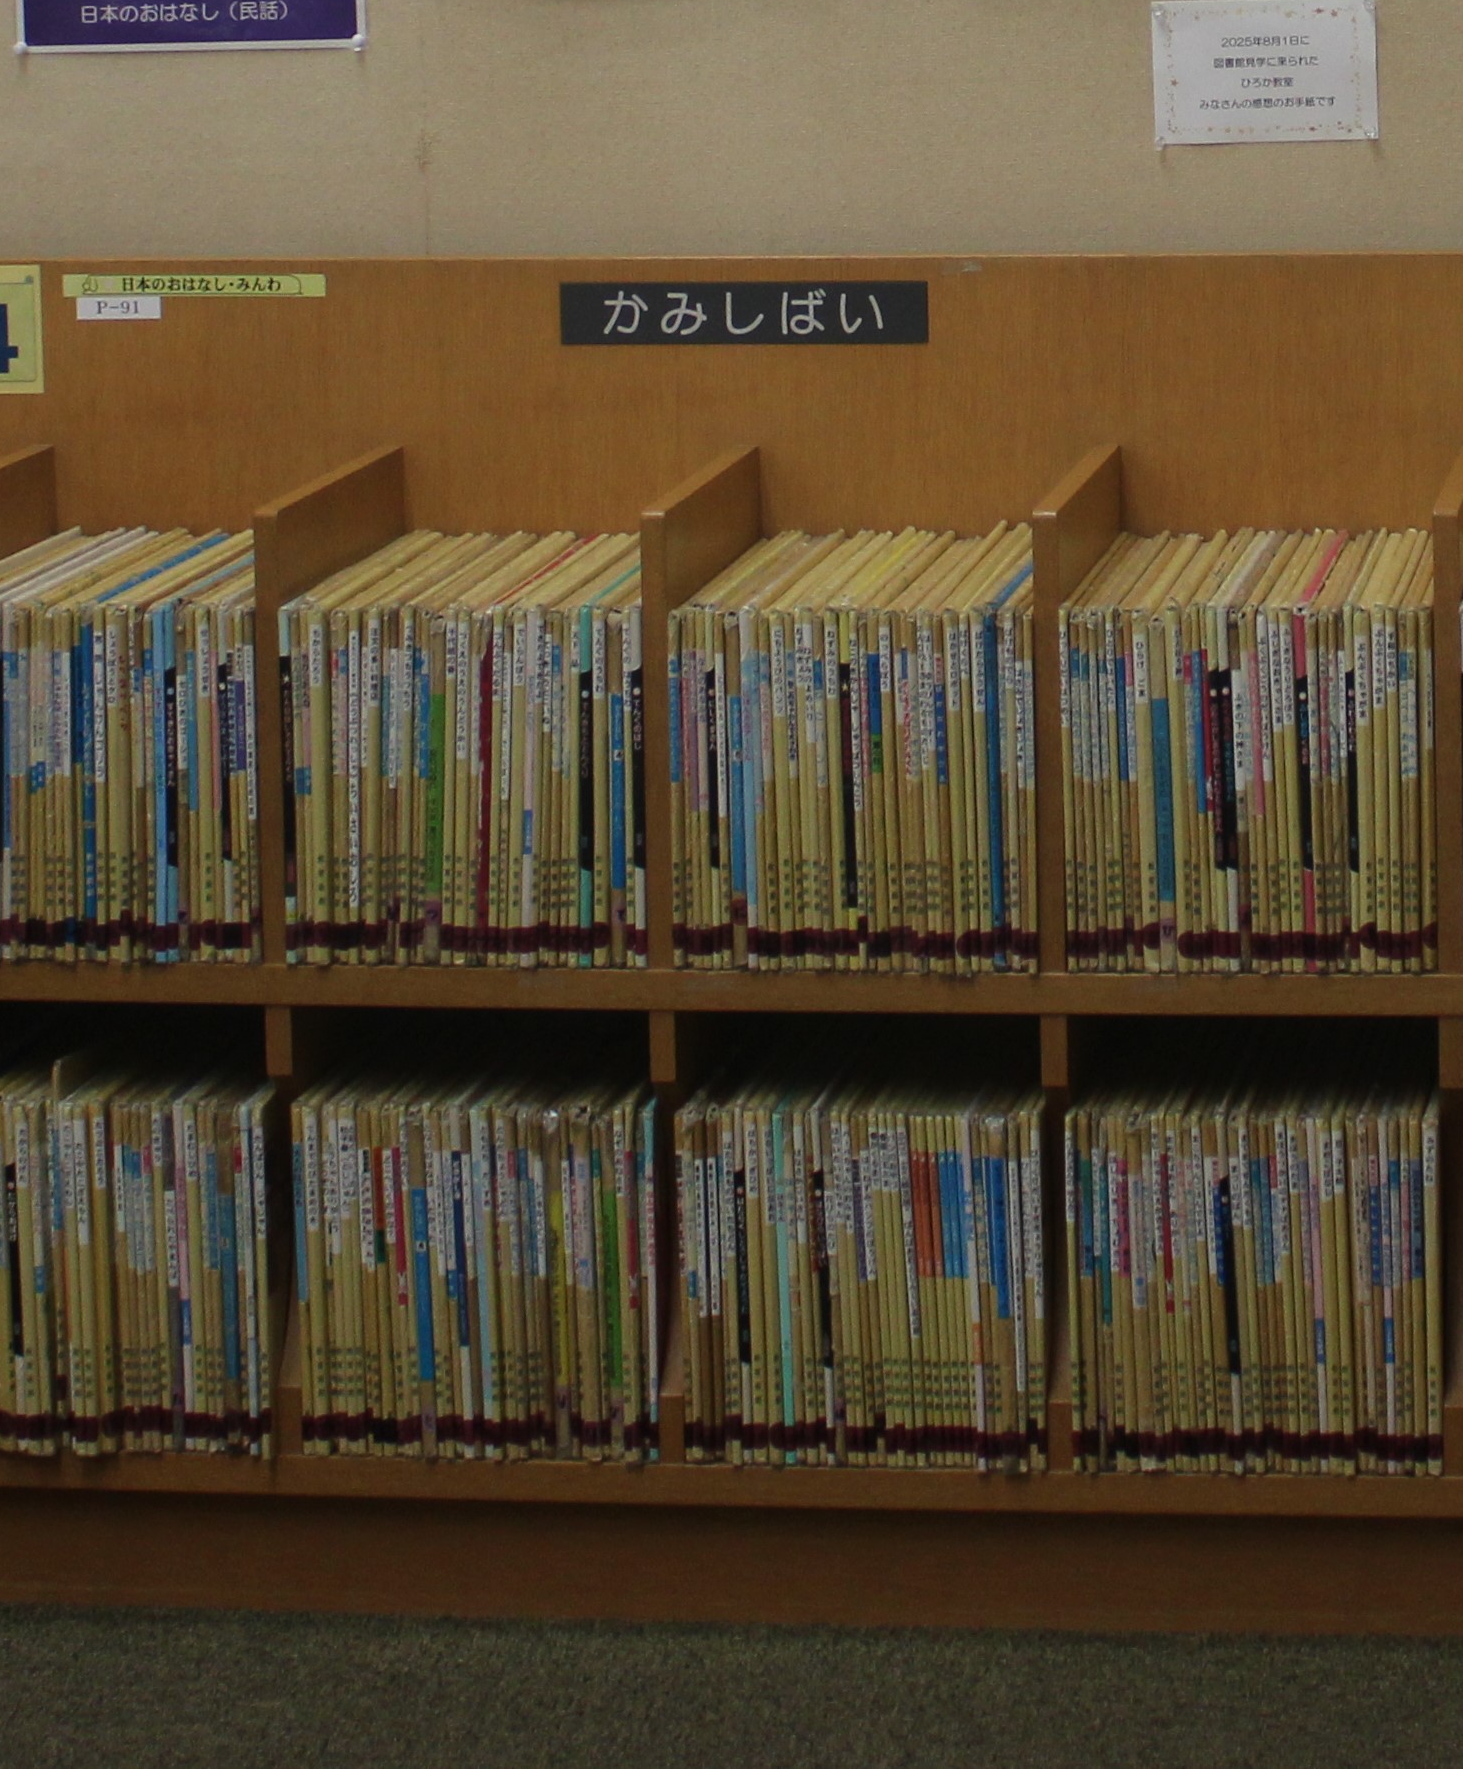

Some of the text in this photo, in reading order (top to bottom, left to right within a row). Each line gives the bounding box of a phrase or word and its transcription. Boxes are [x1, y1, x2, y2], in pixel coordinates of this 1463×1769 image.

[81, 0, 290, 24] 日本のおはなし（民話）
[1221, 35, 1310, 48] 2025年8月1日に
[1213, 56, 1319, 69] 図書館見学に来られた
[1240, 76, 1294, 88] ひろか教室
[1199, 96, 1336, 110] みなさんの感想のお手紙です
[121, 276, 283, 294] 日本のおはなし・みんわ
[95, 298, 142, 317] P-91
[603, 288, 884, 335] かみしばい
